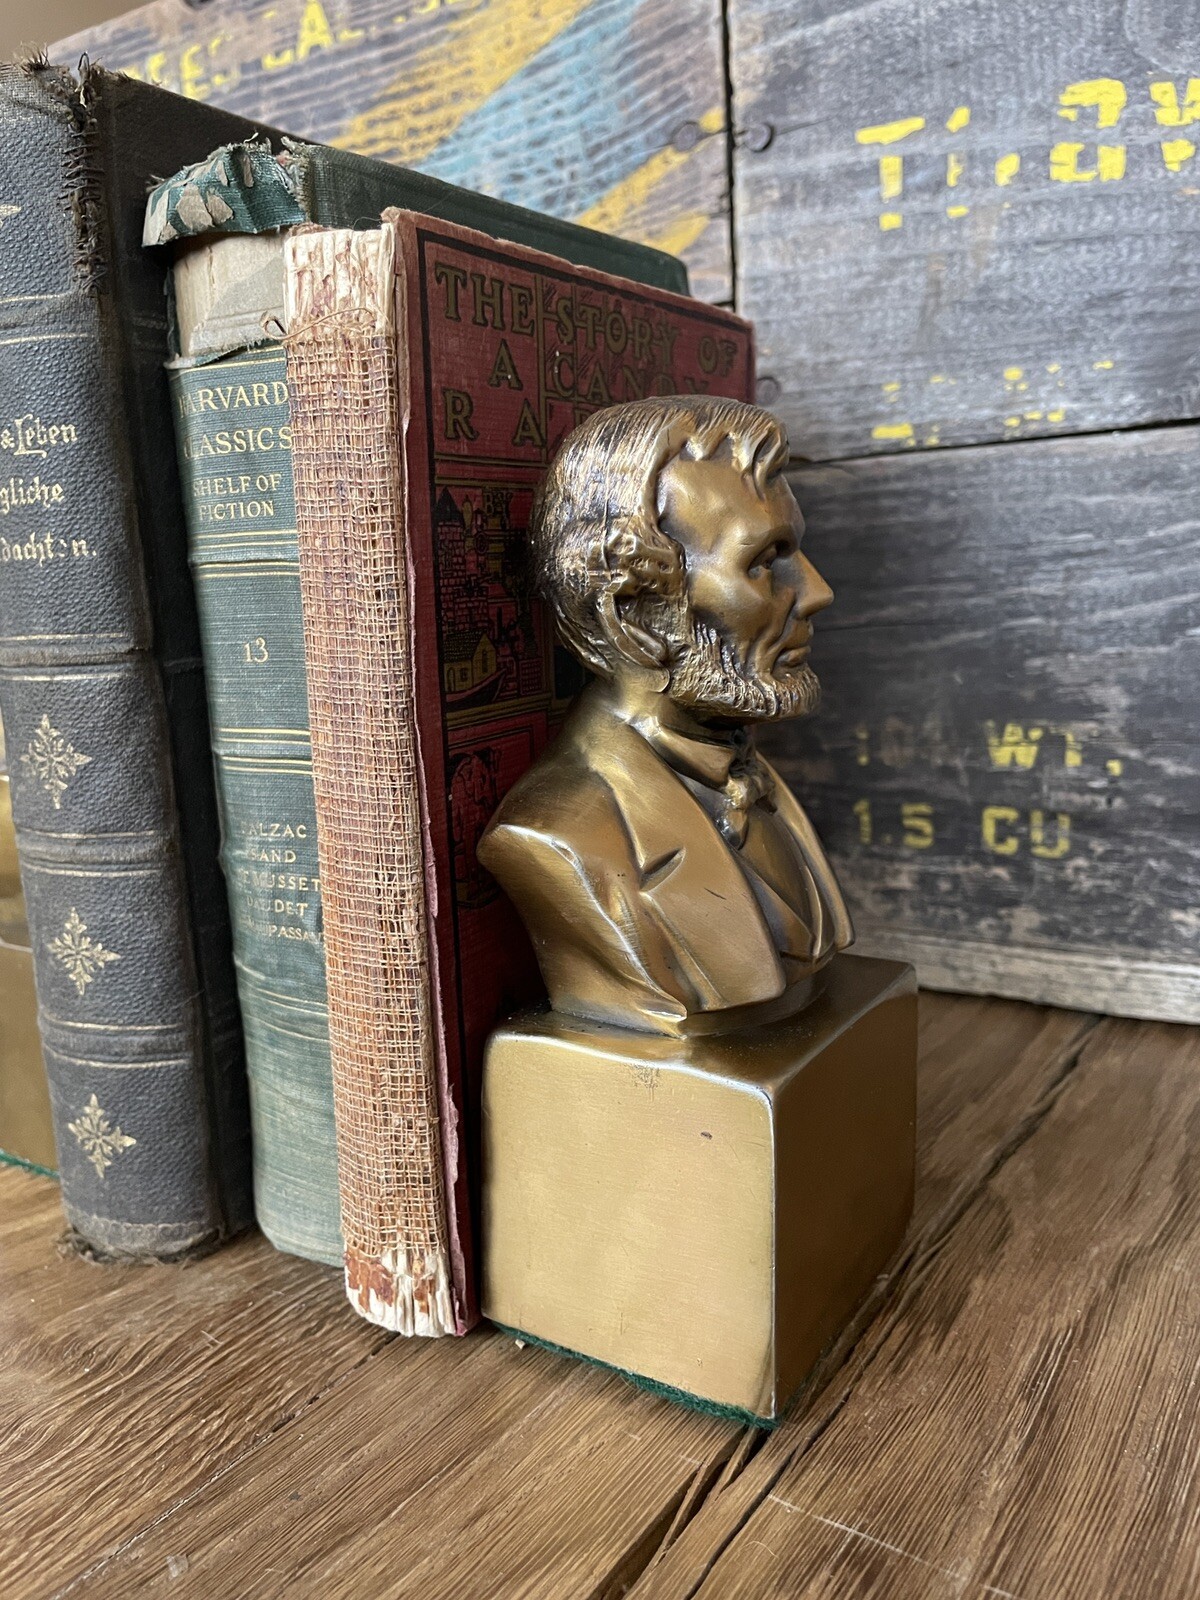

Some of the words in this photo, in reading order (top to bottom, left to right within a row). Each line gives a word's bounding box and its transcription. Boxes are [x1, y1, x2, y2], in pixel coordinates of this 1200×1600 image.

[434, 261, 535, 338] THE
[554, 295, 680, 372] STORY
[698, 335, 739, 378] OF
[487, 339, 524, 391] A
[193, 475, 251, 498] SHELF
[256, 473, 282, 492] OF
[200, 500, 275, 521] FICTION
[243, 637, 269, 663] 13
[240, 821, 308, 839] ALZAC
[981, 805, 1070, 858] CU
[250, 848, 297, 864] SAND
